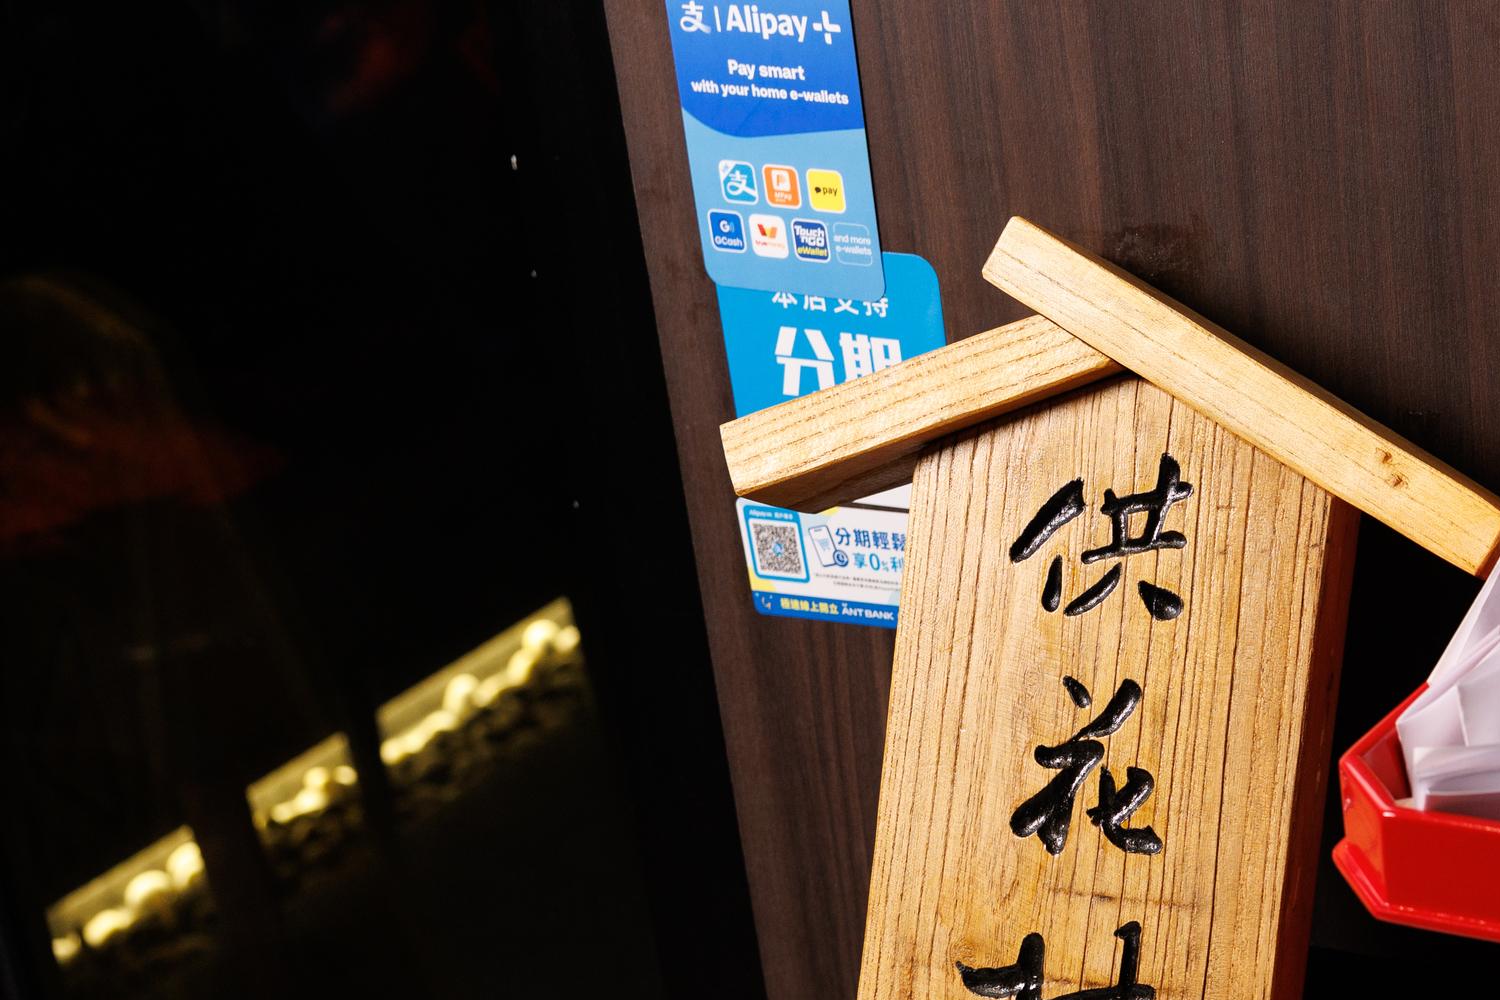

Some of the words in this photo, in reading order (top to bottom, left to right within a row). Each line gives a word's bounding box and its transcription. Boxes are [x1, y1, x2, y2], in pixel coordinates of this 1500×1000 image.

[727, 59, 755, 80] Pay
[759, 65, 806, 81] smart
[691, 79, 719, 94] with
[720, 83, 750, 98] your
[752, 84, 788, 100] home
[790, 90, 849, 105] e-wallets
[794, 224, 825, 238] Touch
[834, 234, 849, 244] and
[864, 608, 895, 621] BANK
